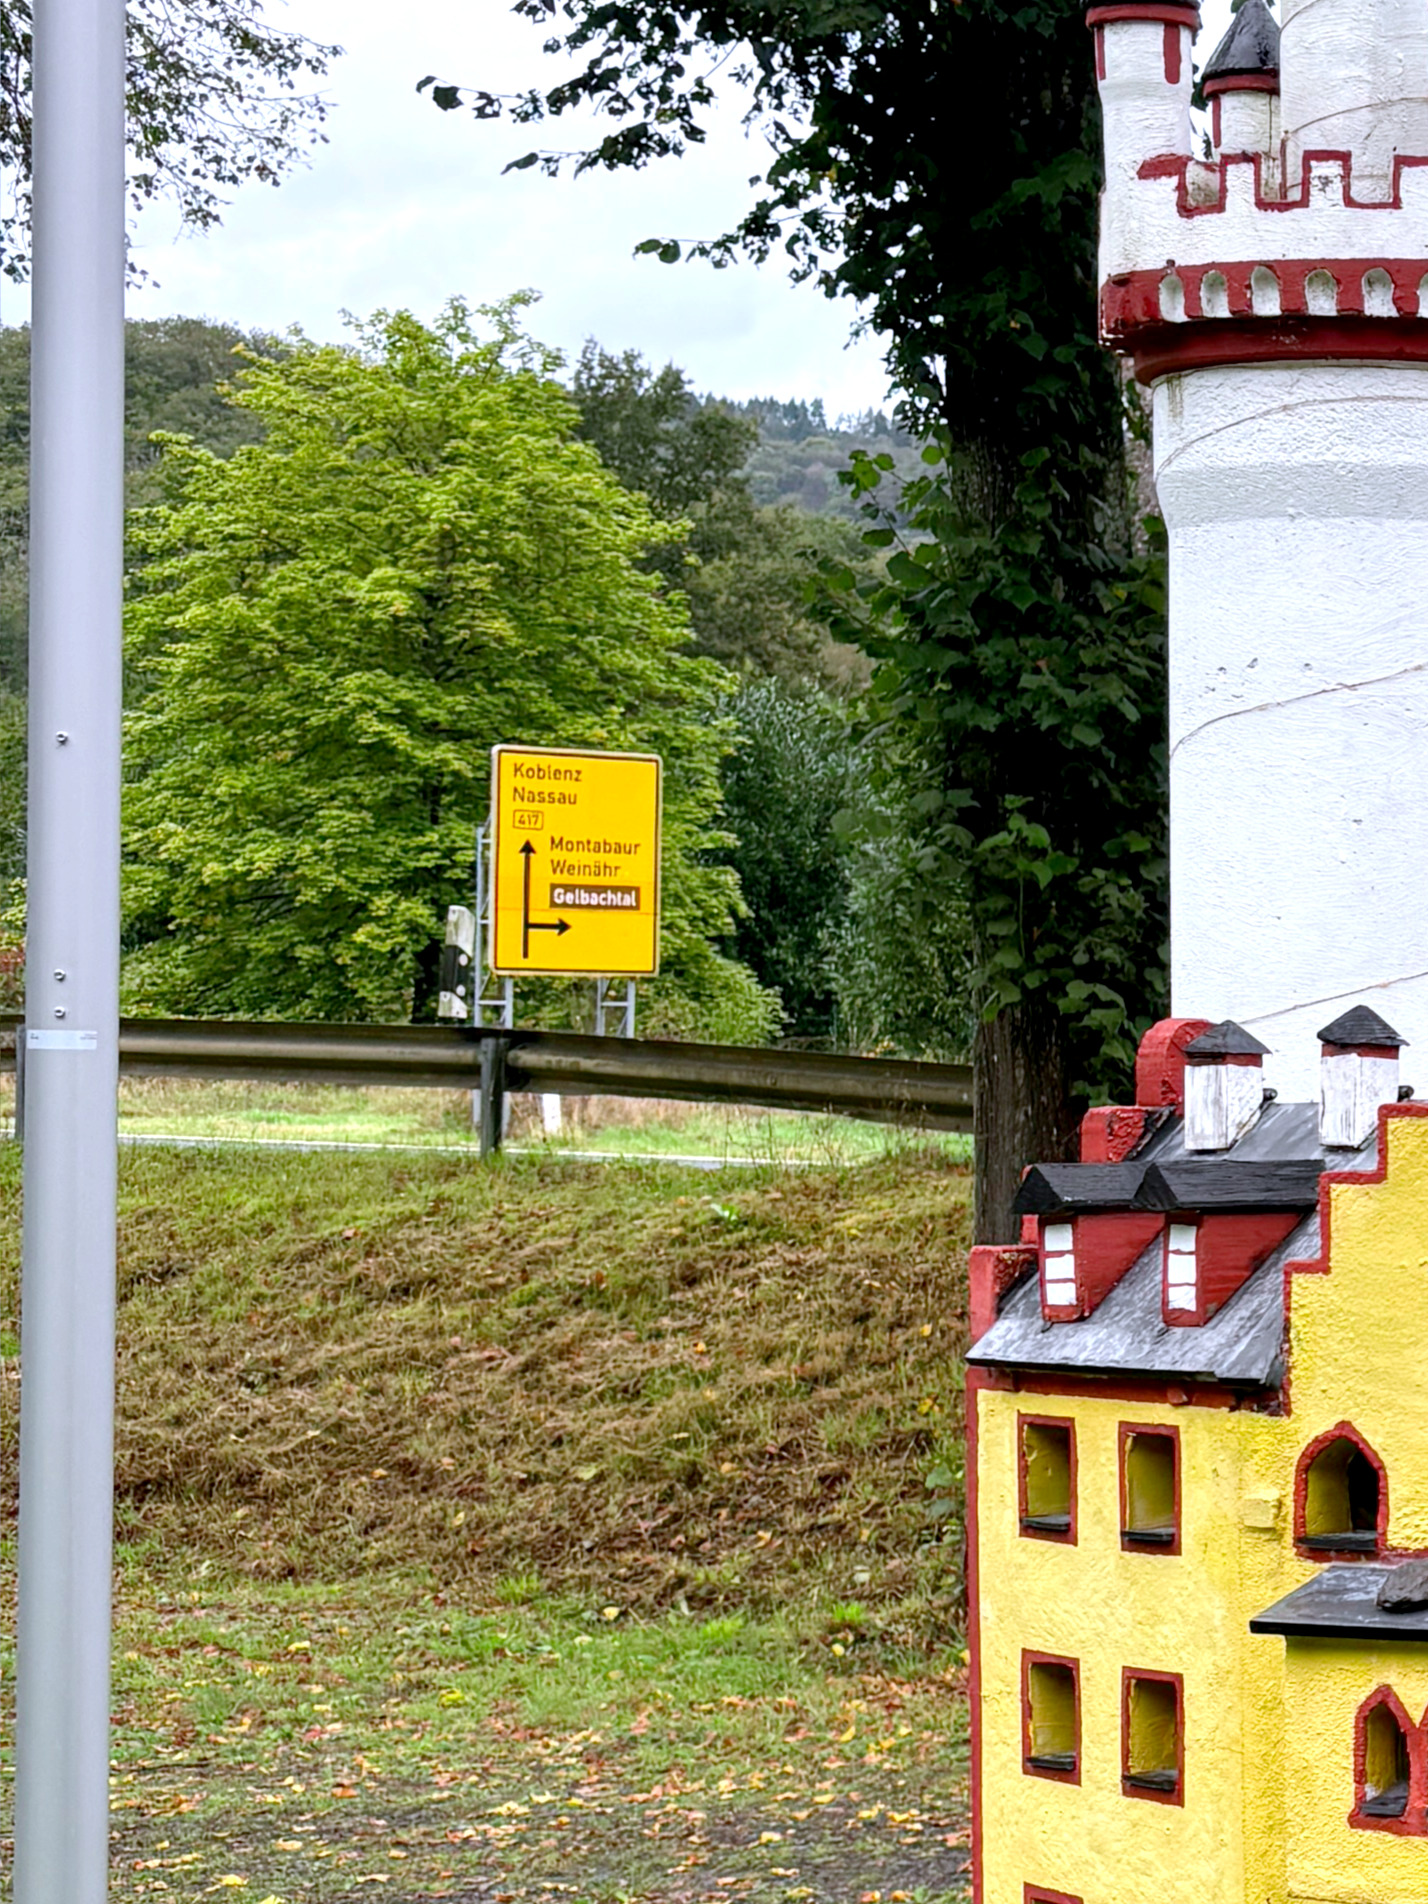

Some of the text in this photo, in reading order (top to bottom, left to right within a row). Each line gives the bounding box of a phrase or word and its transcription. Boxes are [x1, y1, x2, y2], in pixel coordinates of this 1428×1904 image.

[513, 762, 582, 782] Koblenz
[512, 786, 578, 805] Nassau
[518, 813, 540, 828] 417
[550, 836, 641, 855] Montabaur
[550, 859, 621, 878] Weinähr
[553, 887, 637, 908] Gelbachtal
